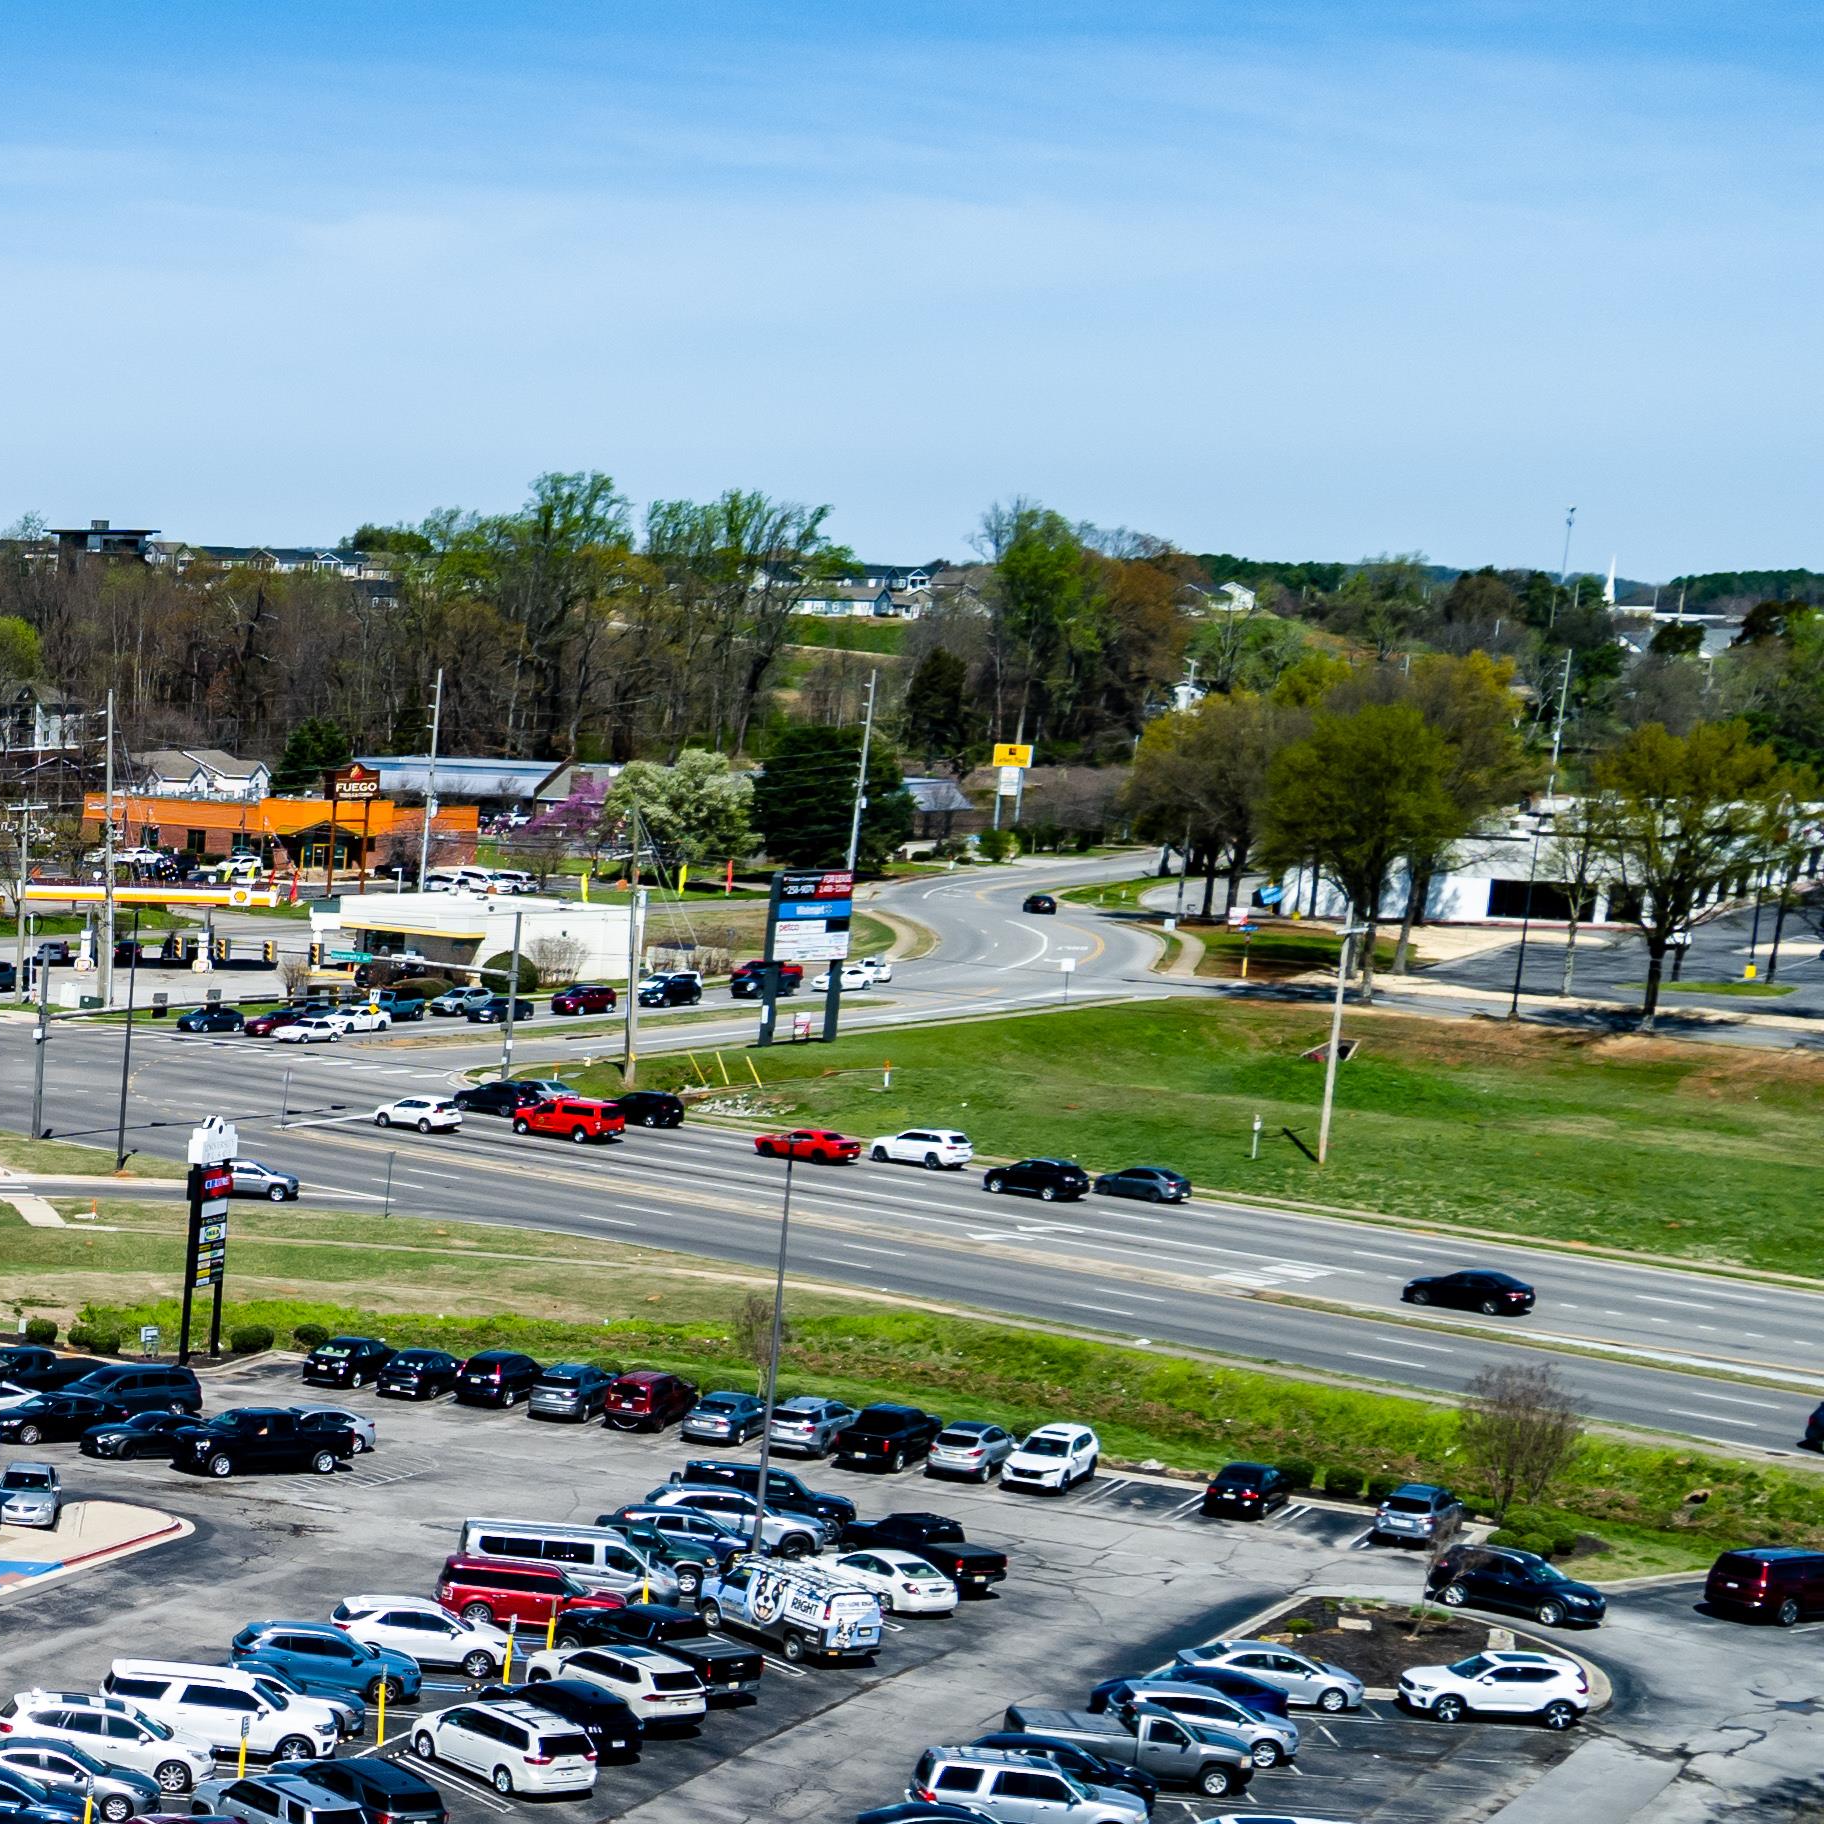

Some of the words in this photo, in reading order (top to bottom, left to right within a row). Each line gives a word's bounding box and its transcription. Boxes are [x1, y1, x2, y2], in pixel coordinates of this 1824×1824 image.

[335, 782, 378, 792] FUEGO
[331, 951, 361, 961] University
[791, 1597, 819, 1617] RIGHT
